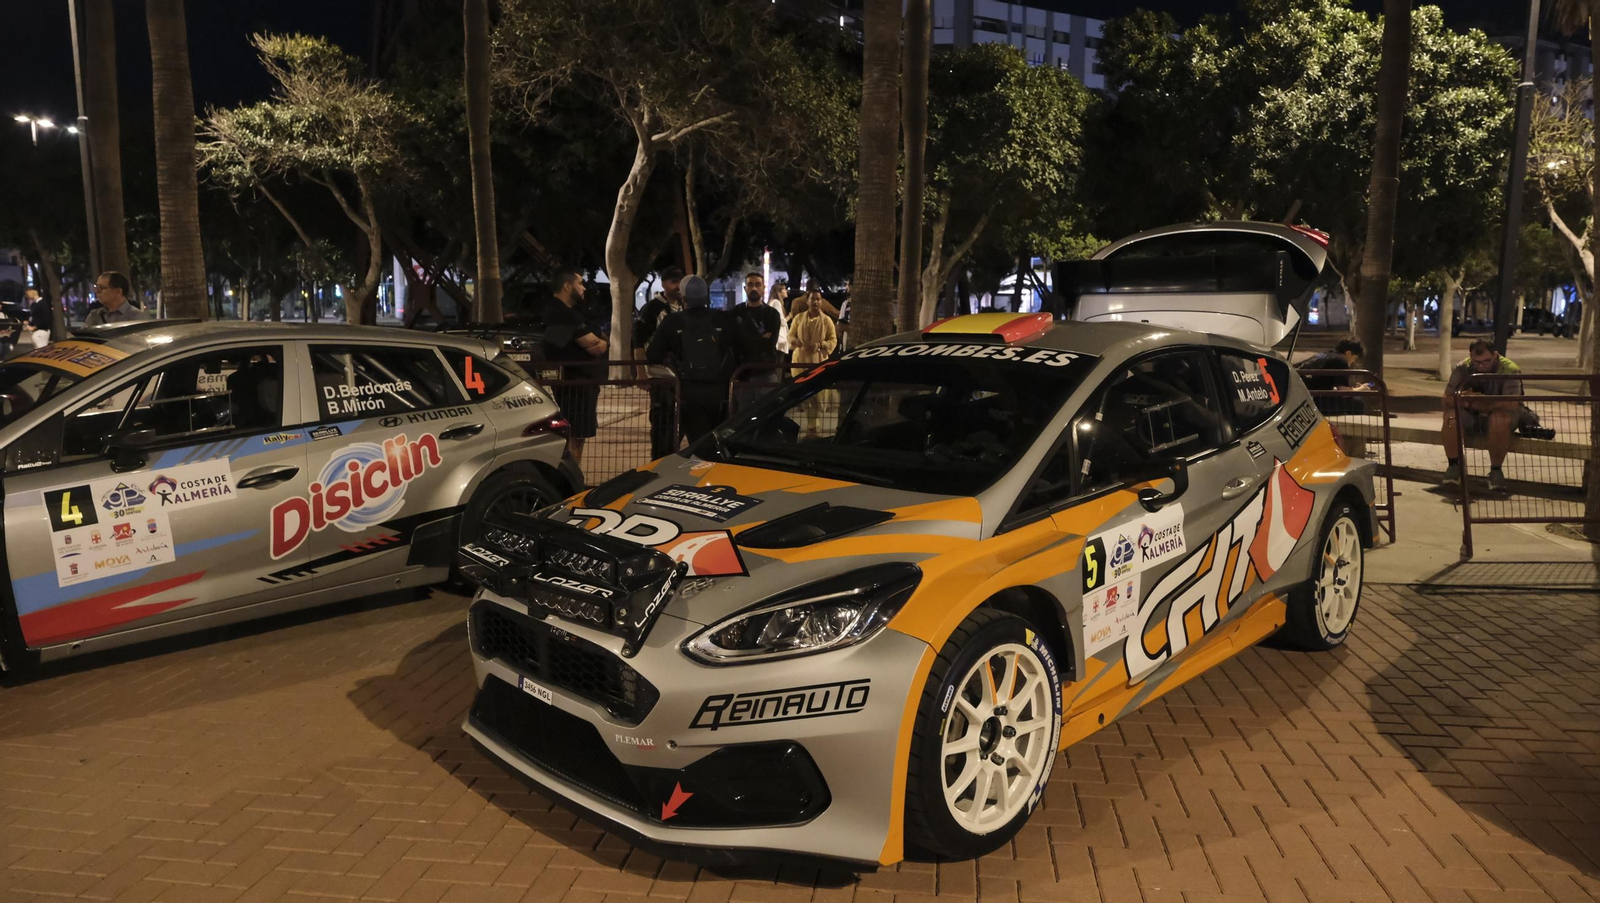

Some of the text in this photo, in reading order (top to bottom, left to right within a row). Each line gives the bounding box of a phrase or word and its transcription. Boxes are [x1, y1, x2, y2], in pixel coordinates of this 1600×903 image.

[840, 344, 1080, 368] COLOMBES.ES
[464, 356, 486, 395] 4
[1231, 370, 1260, 383] D. Perez
[1257, 357, 1280, 405] 5
[323, 379, 413, 400] D.Berdomás
[505, 396, 544, 410] NIMO
[408, 406, 473, 424] HYUNDAI
[180, 474, 228, 490] COSTA DE
[174, 483, 232, 505] ALMERÍA
[270, 433, 443, 560] Disiclin
[61, 492, 84, 525] 4
[113, 509, 125, 519] 30
[1154, 523, 1181, 542] COSTA DE
[1149, 535, 1184, 560] ALMERÍA
[1084, 544, 1098, 589] 5
[1039, 643, 1062, 710] MICHELIN
[524, 680, 551, 702] 3456 NGL
[615, 733, 655, 747] PLEMAR
